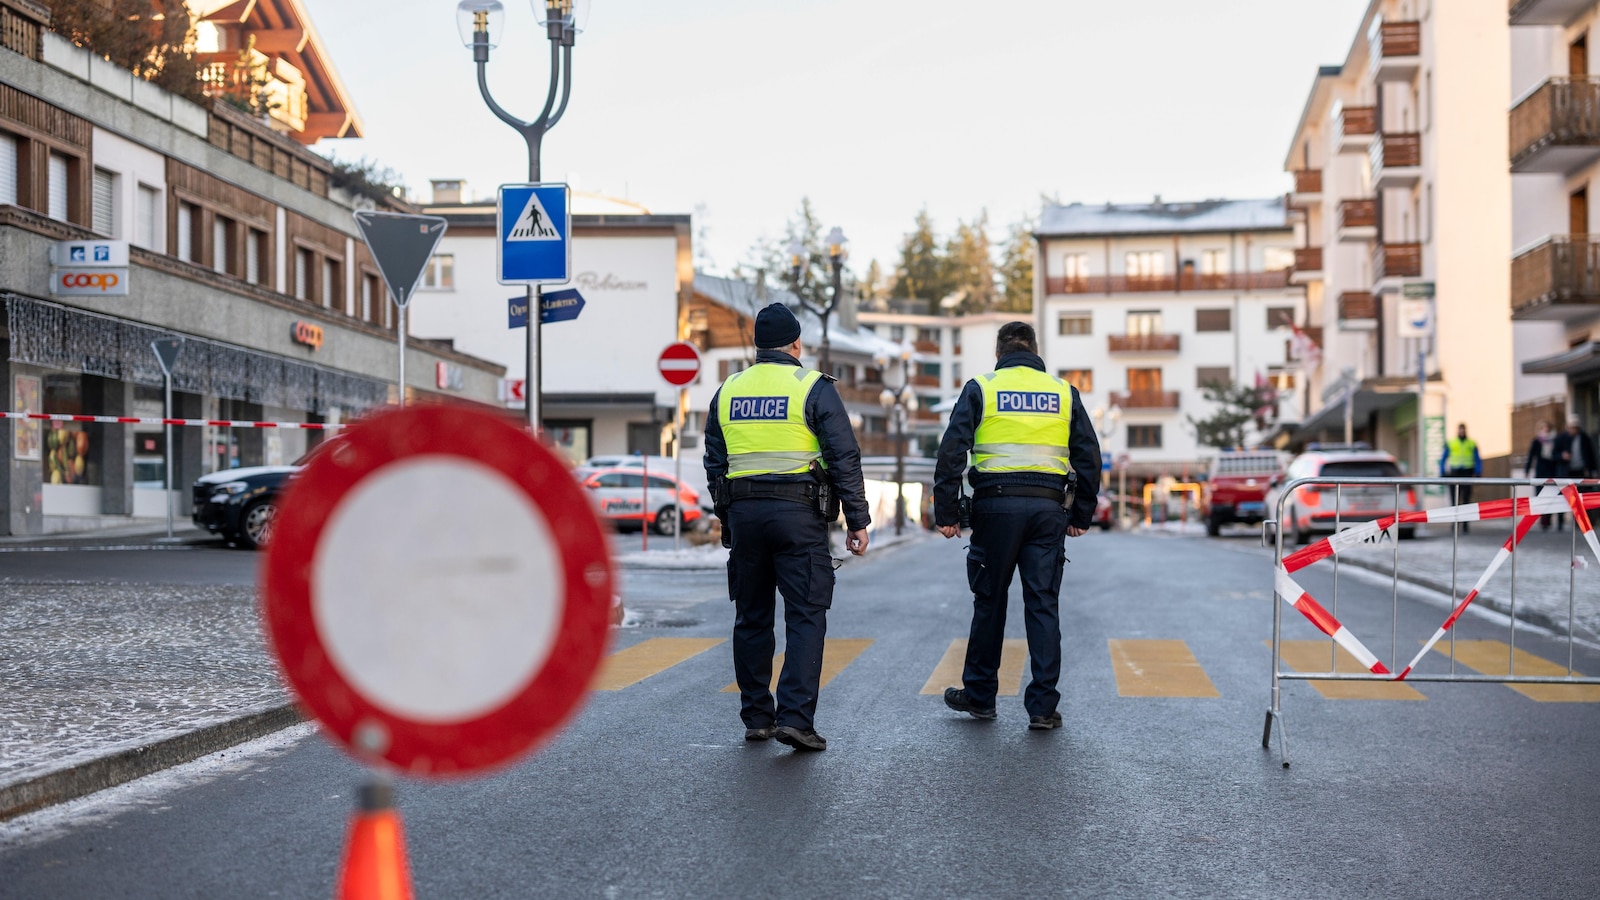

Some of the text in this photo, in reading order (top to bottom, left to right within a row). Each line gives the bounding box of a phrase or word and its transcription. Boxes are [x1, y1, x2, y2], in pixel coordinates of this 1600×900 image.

[62, 273, 119, 292] coop
[731, 399, 785, 417] POLICE
[1000, 393, 1057, 411] POLICE
